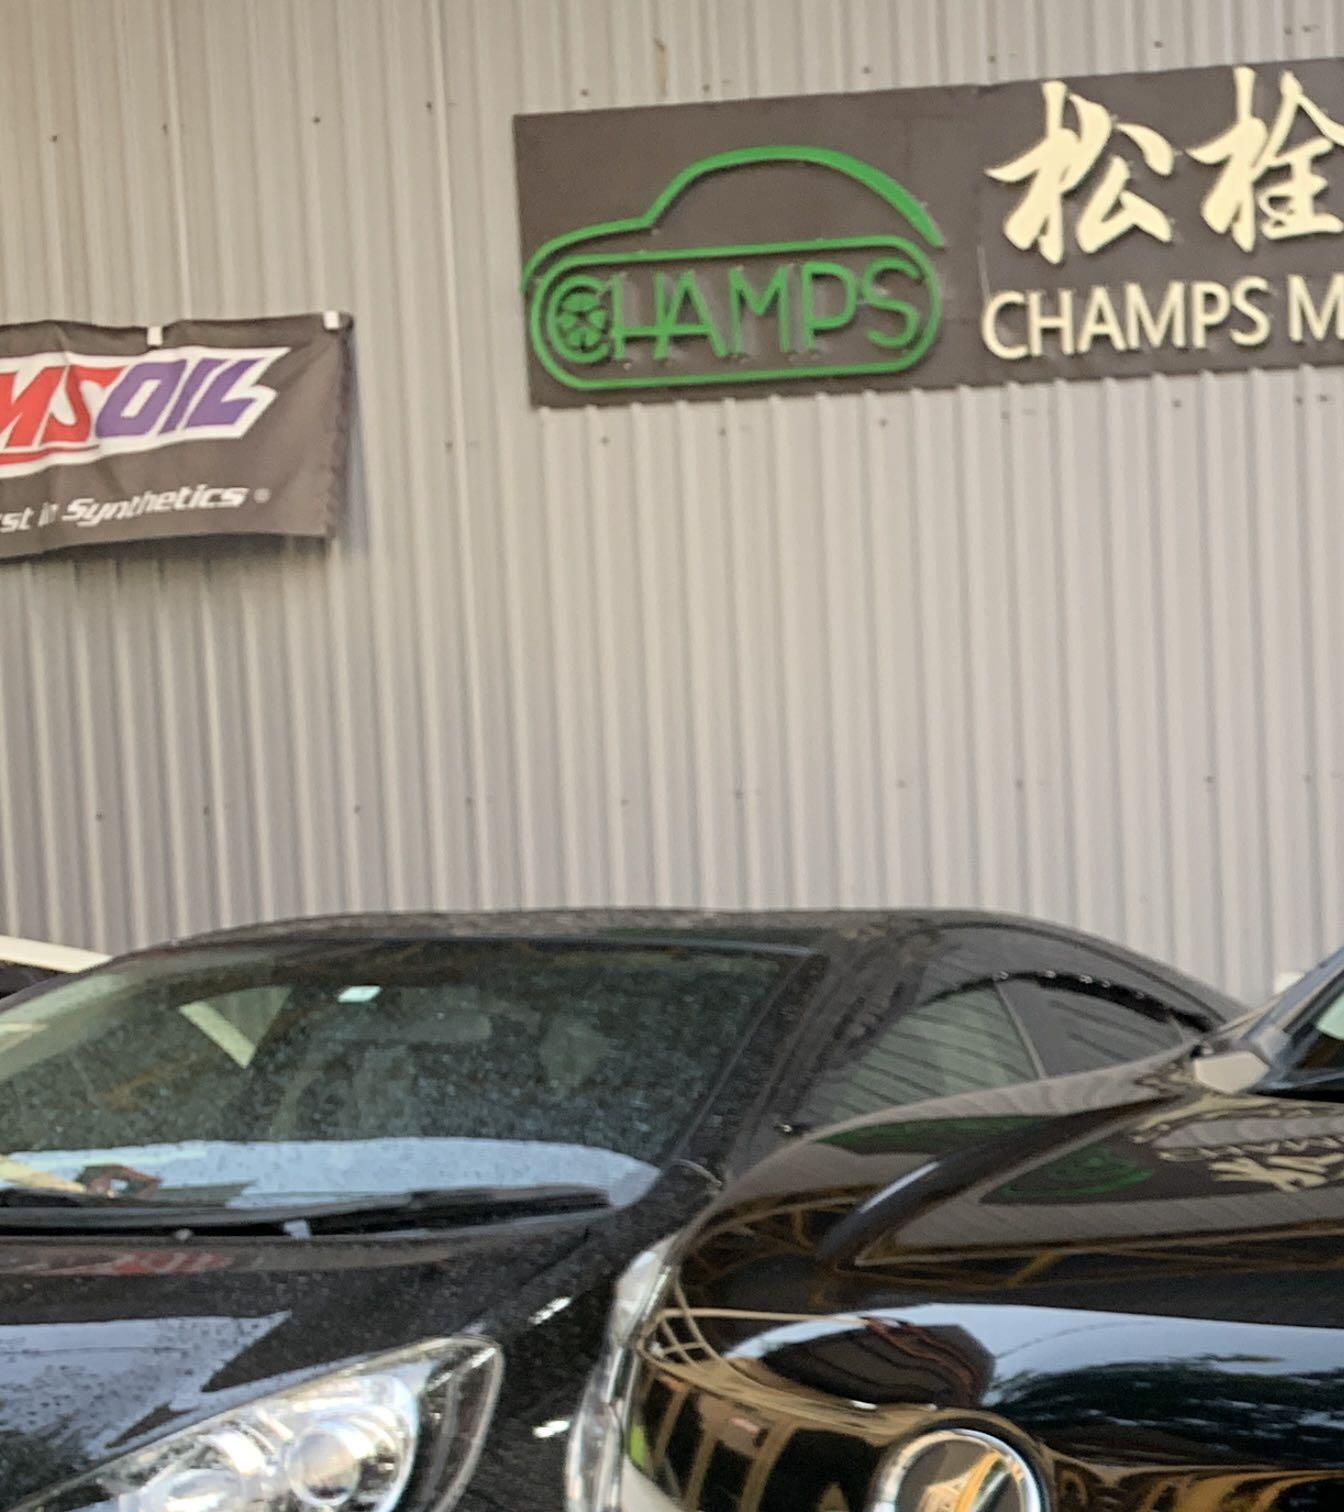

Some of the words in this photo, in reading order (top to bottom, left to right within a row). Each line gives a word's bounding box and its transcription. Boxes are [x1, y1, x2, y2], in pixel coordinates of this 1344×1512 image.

[981, 276, 1272, 360] CHAMPS
[0, 506, 33, 533] st
[62, 484, 249, 527] Synthetics
